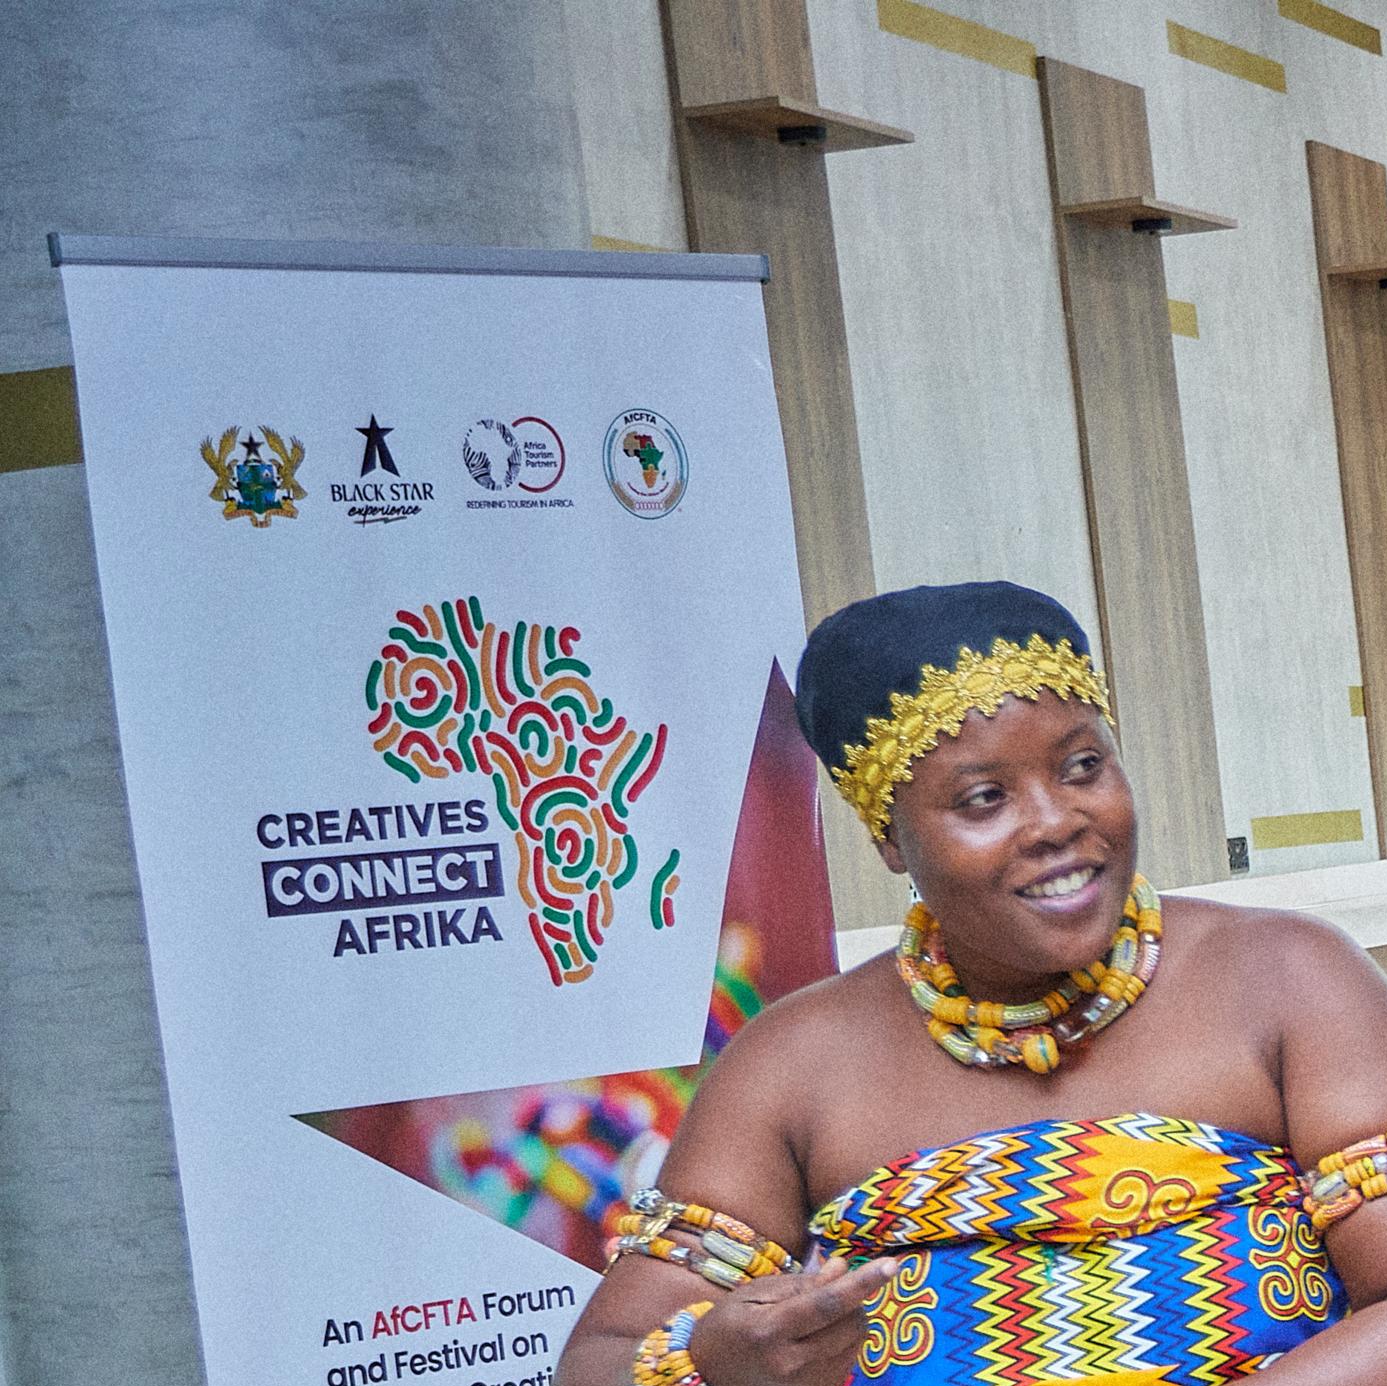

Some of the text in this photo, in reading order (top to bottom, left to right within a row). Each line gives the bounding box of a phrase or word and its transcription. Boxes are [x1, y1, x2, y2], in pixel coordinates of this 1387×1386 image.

[524, 442, 546, 450] Africa
[524, 451, 554, 459] Tourism
[525, 460, 557, 468] Partners
[331, 483, 434, 502] BLACK STAR
[466, 499, 574, 509] REDEFINING TOURISM IN AFRICA
[348, 504, 422, 528] experience
[257, 799, 489, 849] CREATIVES
[271, 851, 493, 906] CONNECT
[333, 906, 504, 957] AFRIKA
[322, 1284, 576, 1347] An AfCFTA Forum
[395, 1334, 505, 1379] Festival
[512, 1332, 548, 1358] on
